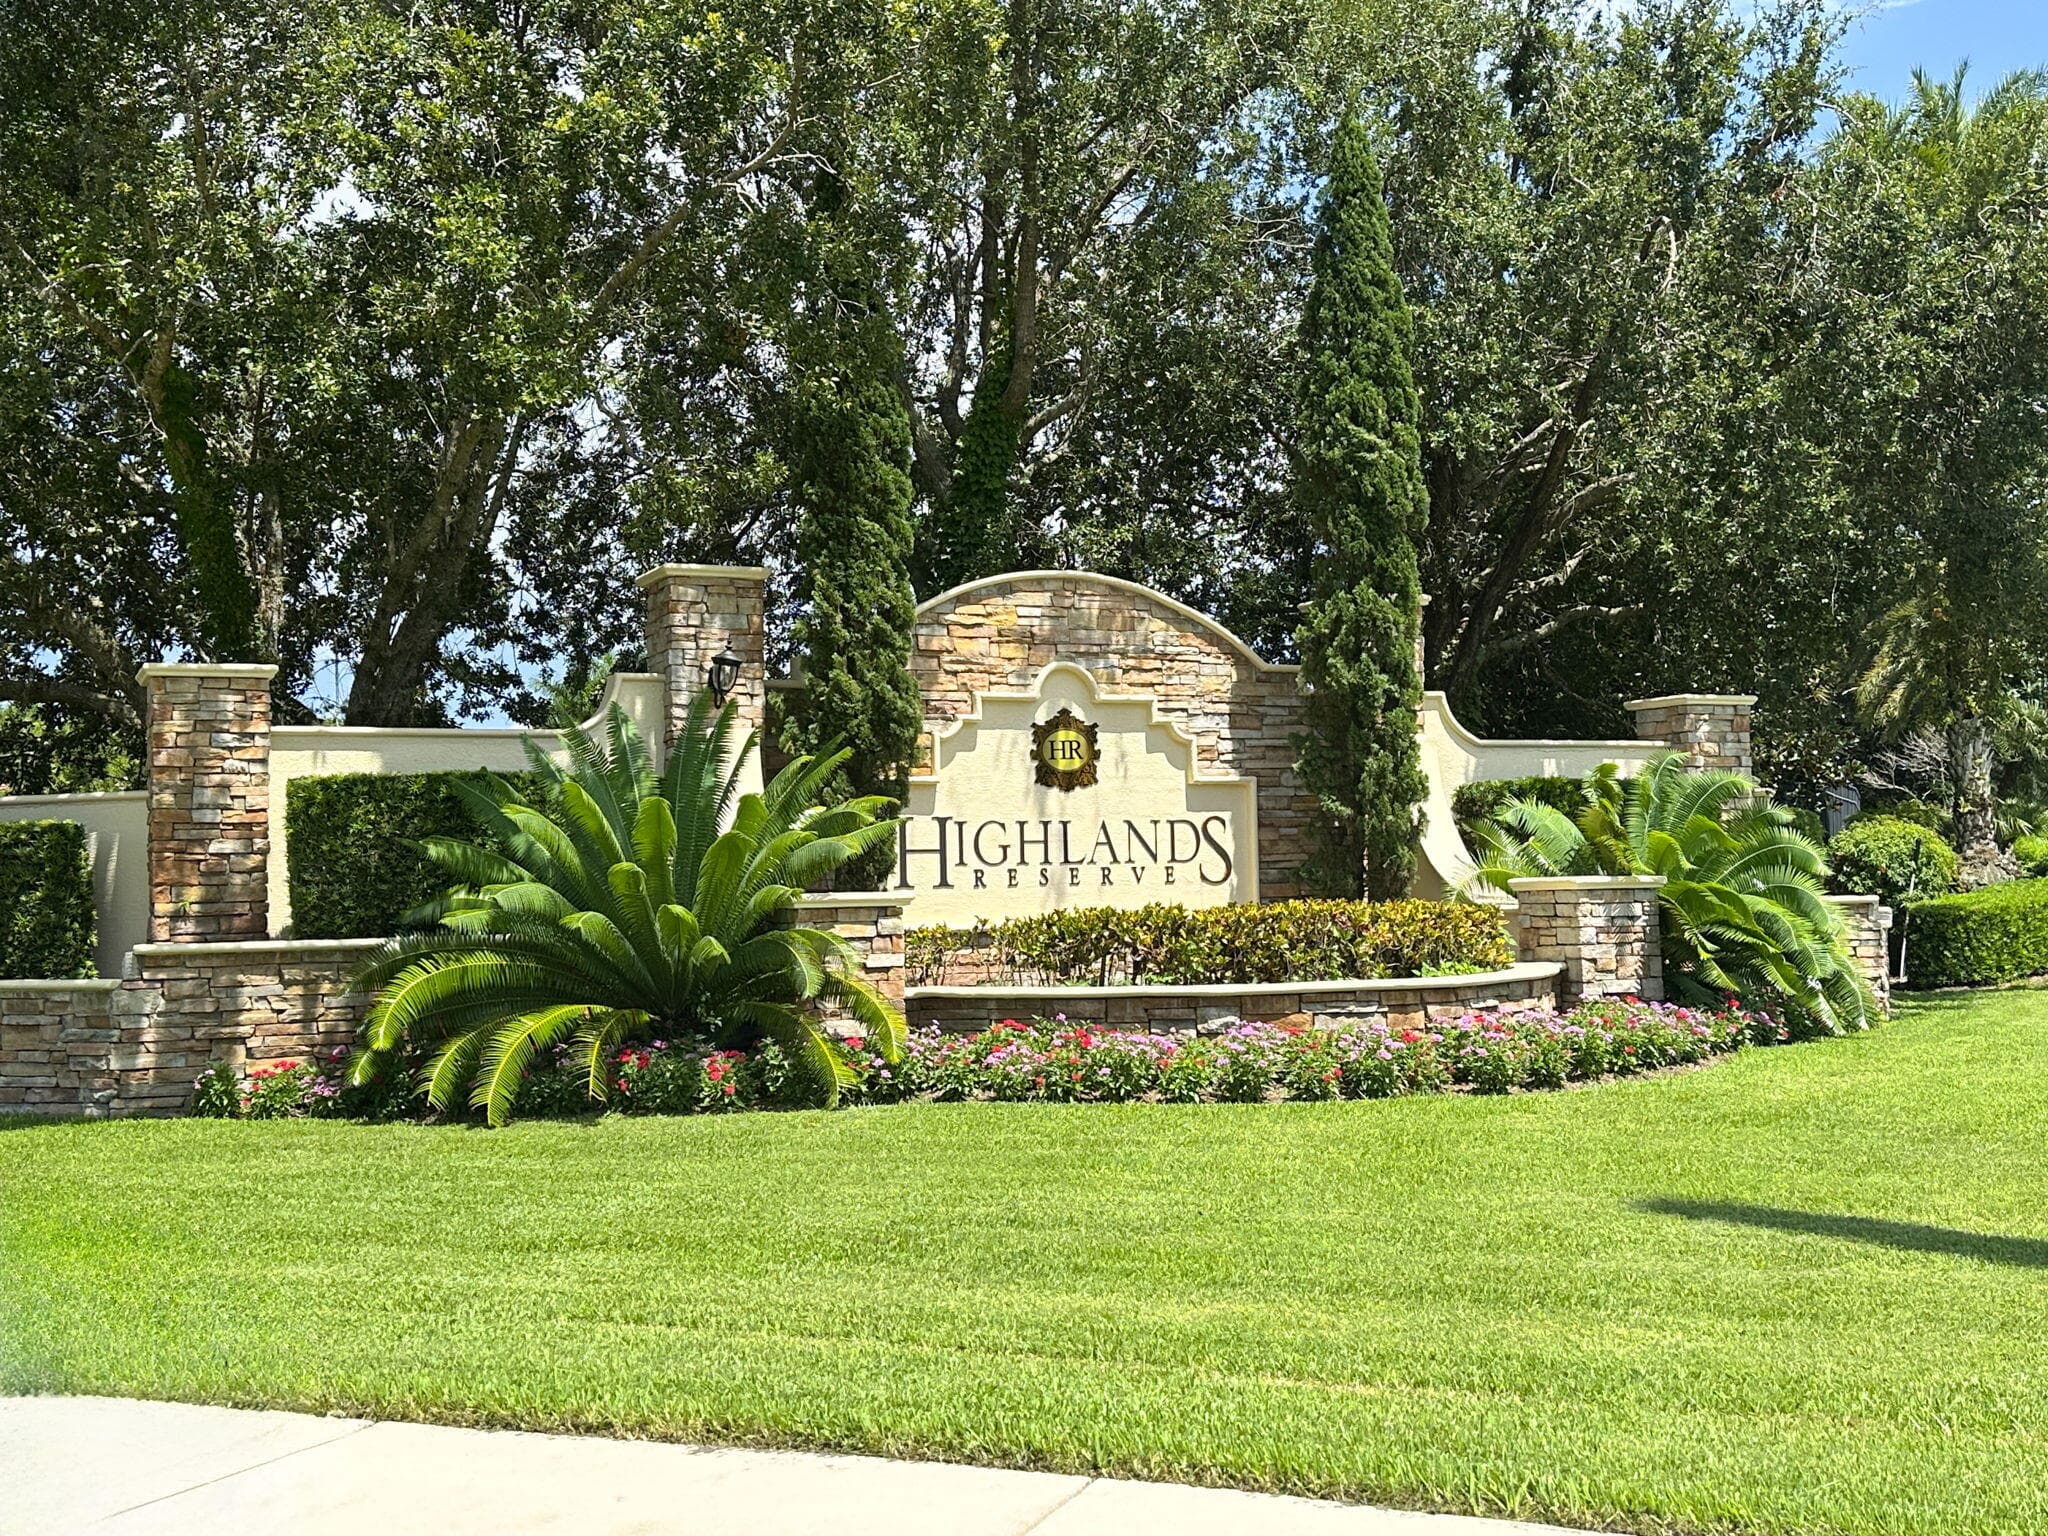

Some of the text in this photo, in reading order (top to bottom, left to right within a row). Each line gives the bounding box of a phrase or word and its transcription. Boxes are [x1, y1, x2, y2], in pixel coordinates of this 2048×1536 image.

[1049, 739, 1084, 761] HR
[894, 816, 1232, 890] HIGHLANDS
[974, 866, 1175, 889] RESERVE
